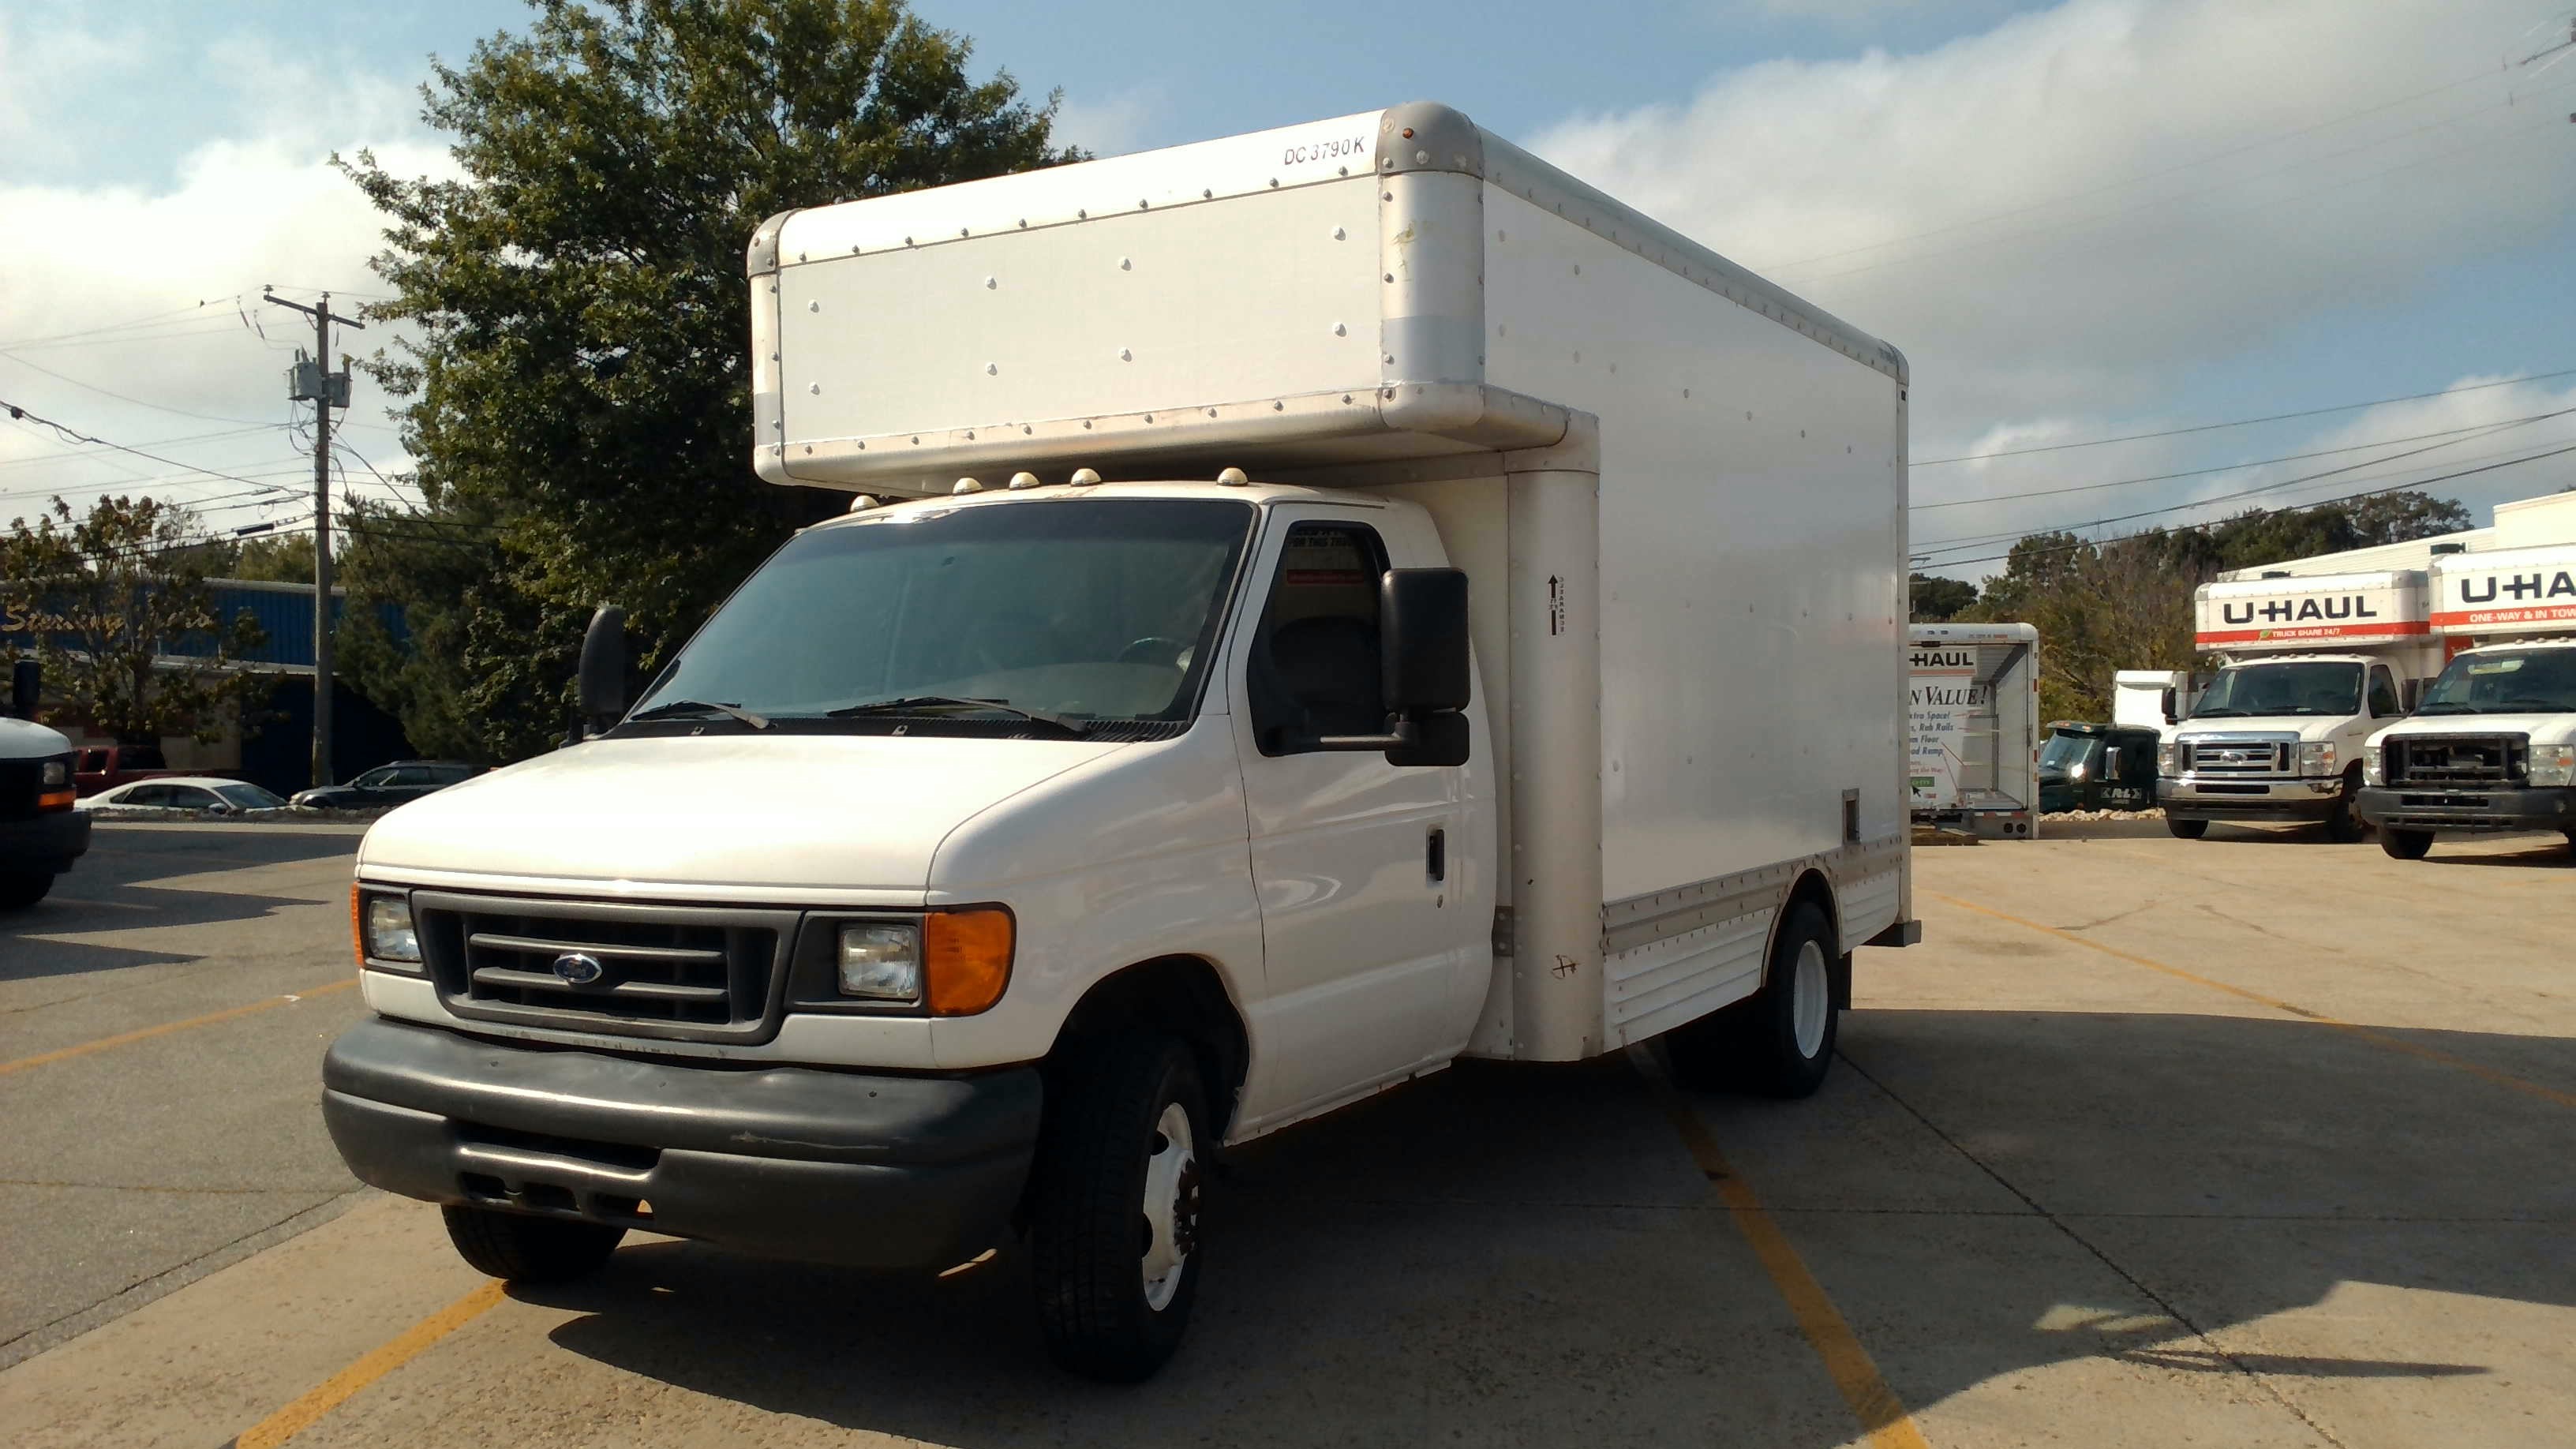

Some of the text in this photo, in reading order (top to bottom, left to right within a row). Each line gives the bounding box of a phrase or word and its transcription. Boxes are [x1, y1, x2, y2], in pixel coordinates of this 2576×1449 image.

[2223, 595, 2377, 624] U-HAUL
[2469, 611, 2522, 623] ONE-WAY
[2523, 611, 2533, 620] &
[2535, 609, 2548, 619] IN
[2297, 628, 2323, 637] SHARE
